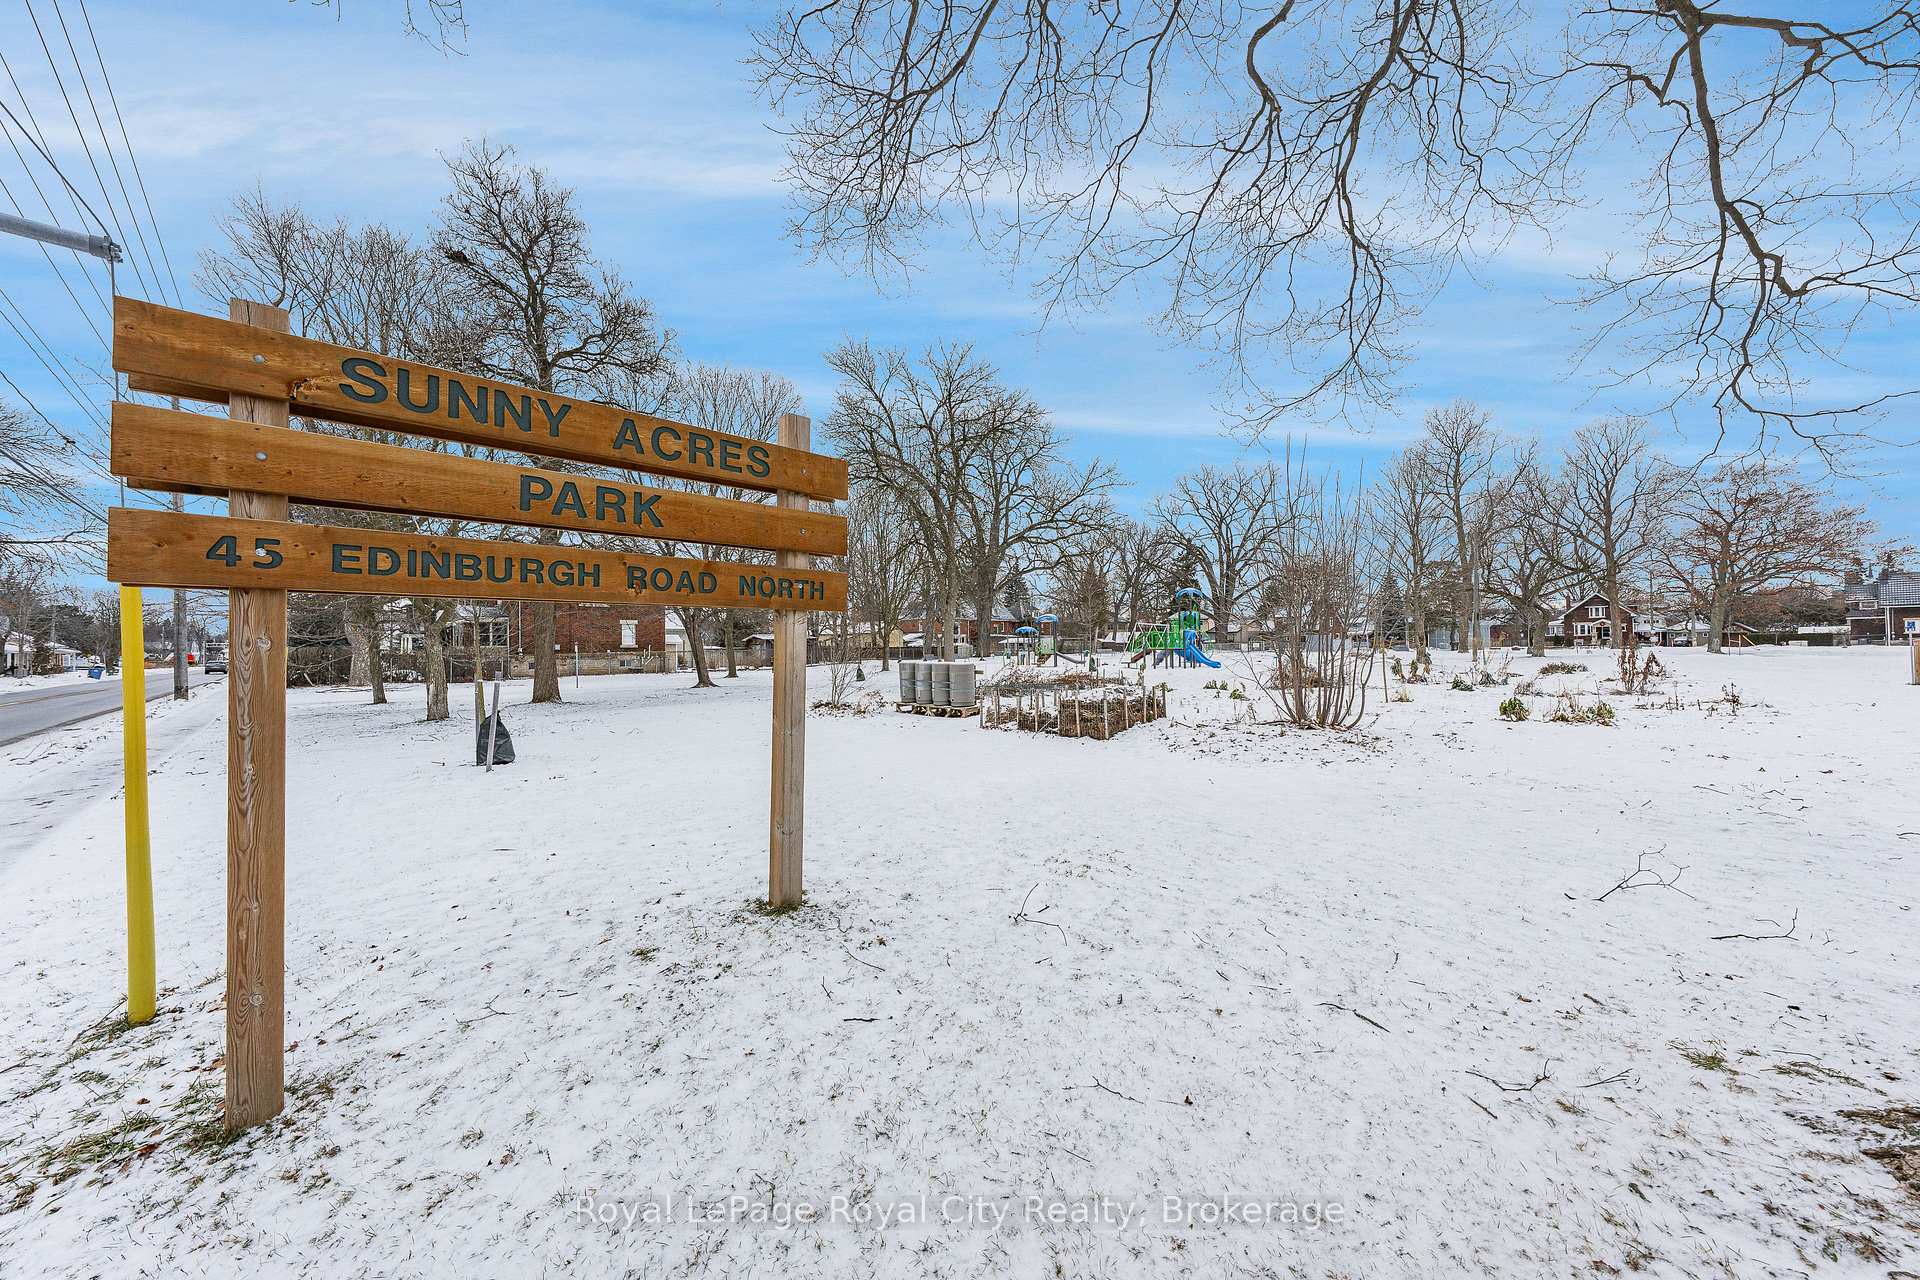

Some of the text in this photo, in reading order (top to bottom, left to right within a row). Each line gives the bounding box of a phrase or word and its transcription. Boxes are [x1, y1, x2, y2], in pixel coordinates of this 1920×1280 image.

[338, 357, 771, 478] SUNNY ACRES
[519, 474, 664, 528] PARK
[206, 535, 825, 600] 45 EDINBURGH ROAD NORTH
